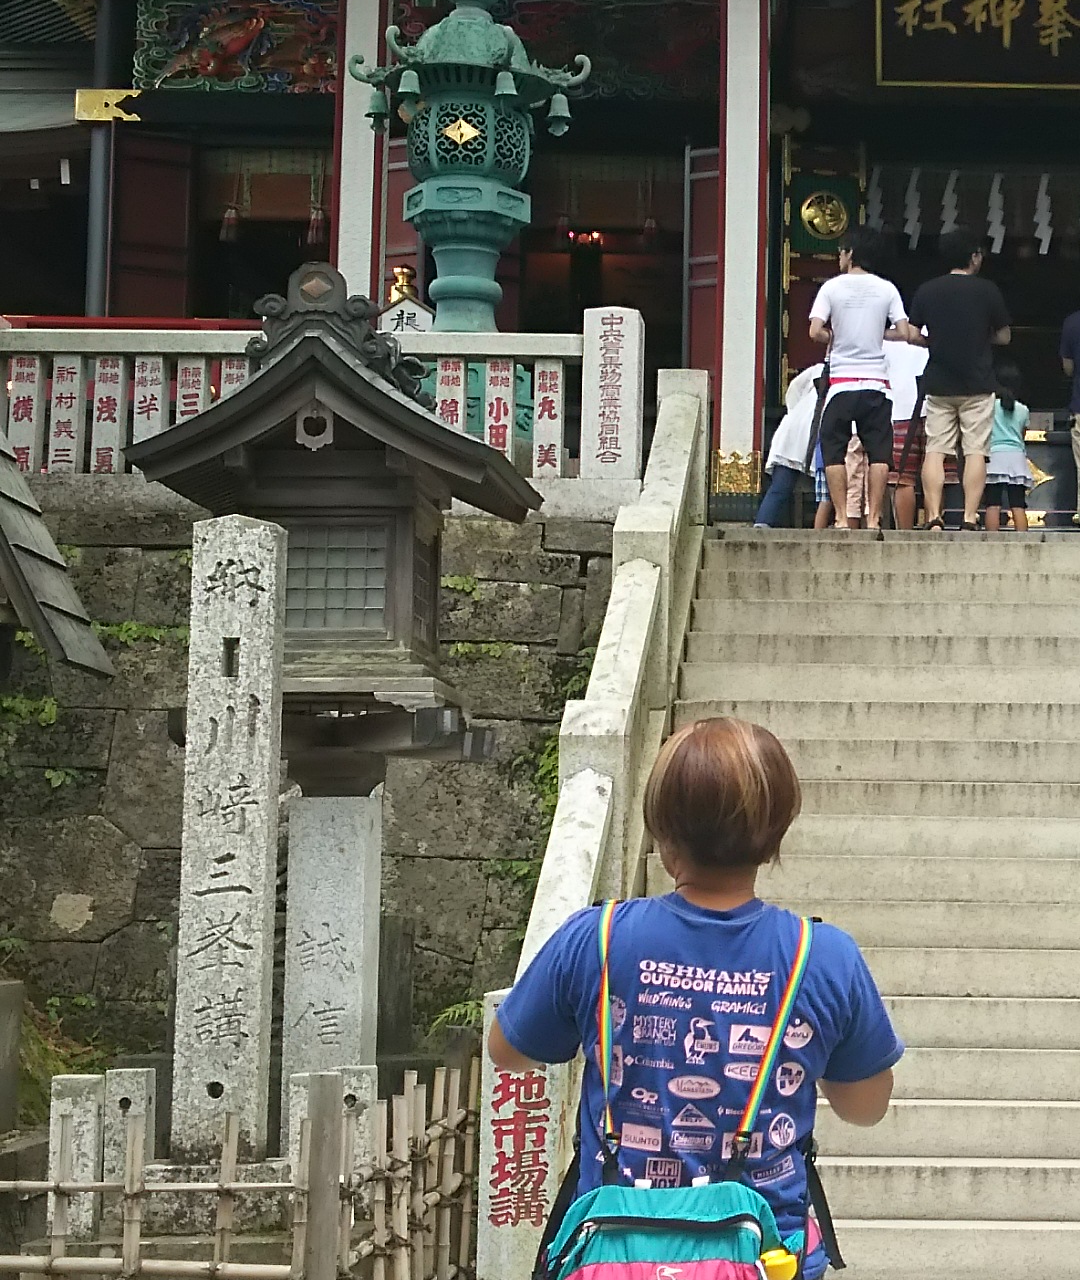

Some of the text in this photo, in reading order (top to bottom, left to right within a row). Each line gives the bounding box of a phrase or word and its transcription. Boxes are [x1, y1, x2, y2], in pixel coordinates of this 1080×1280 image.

[595, 312, 625, 464] 中央青果物商業協同組合
[51, 365, 78, 465] 新村義三
[488, 396, 509, 453] 小田
[639, 959, 772, 984] OSHMAN'S
[639, 971, 768, 996] OUTDOOR FAMILY
[633, 1015, 677, 1030] MYSTERY
[488, 1064, 551, 1229] 地市場講
[623, 1133, 660, 1147] SUUNTO
